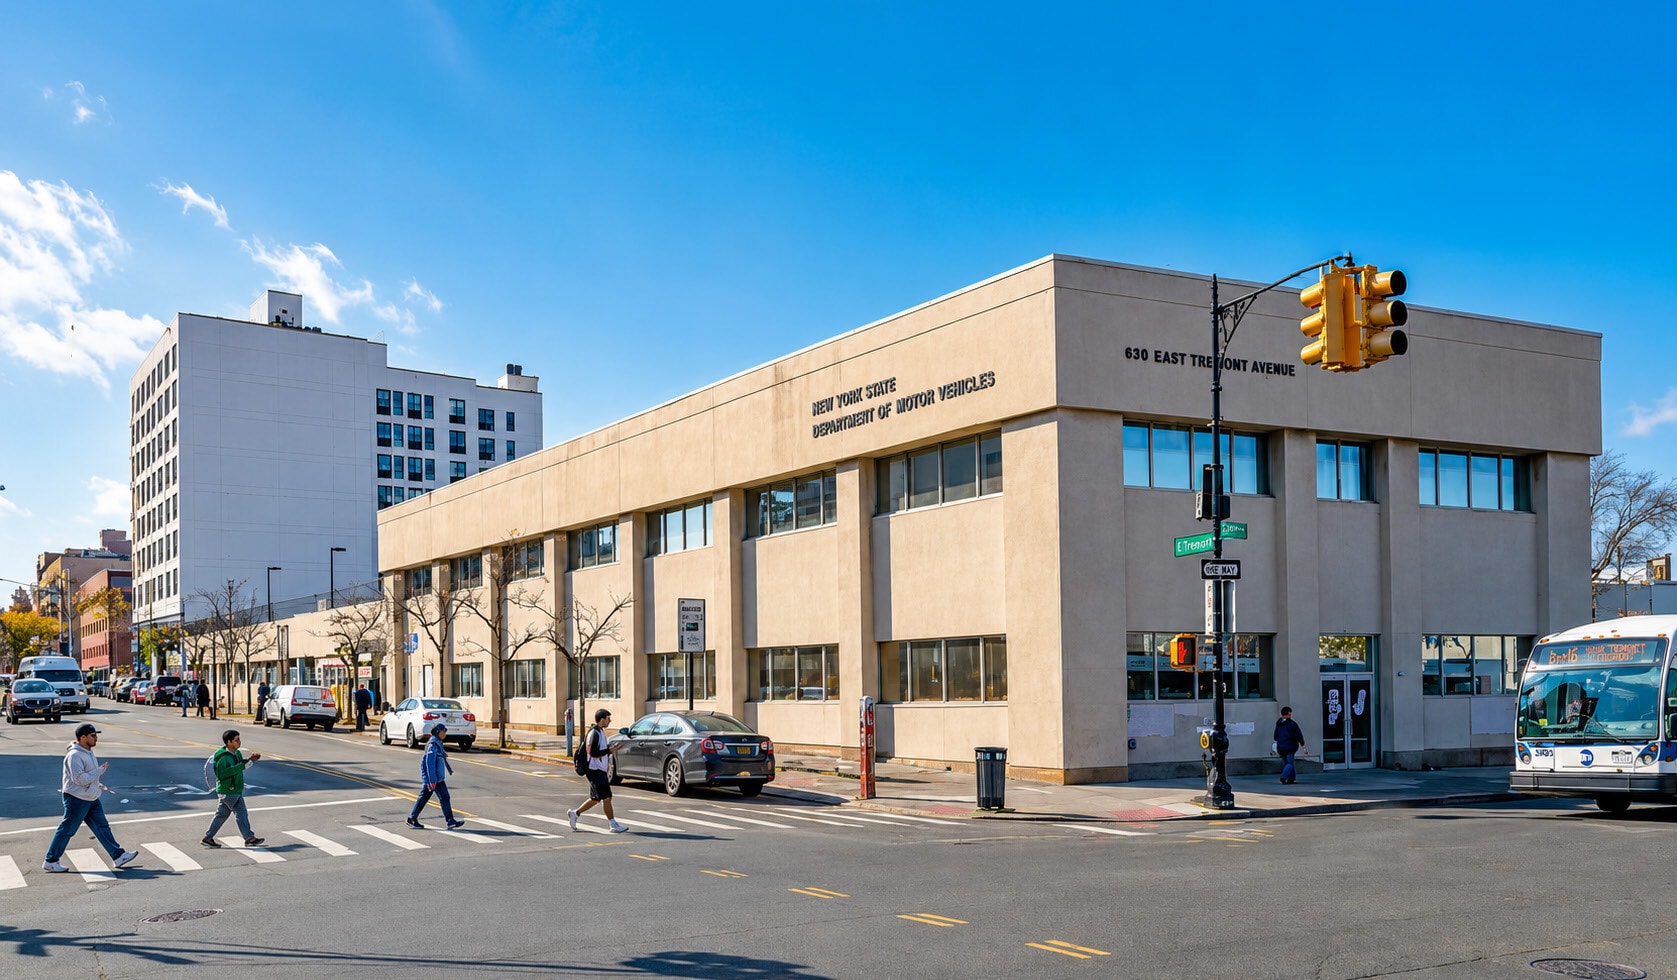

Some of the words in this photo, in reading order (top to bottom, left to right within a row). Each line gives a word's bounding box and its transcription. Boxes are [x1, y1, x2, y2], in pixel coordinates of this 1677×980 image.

[1125, 347, 1148, 361] 630
[1154, 350, 1187, 366] EAST
[1251, 360, 1296, 377] AVENUE
[812, 397, 834, 416] NEW
[836, 387, 863, 409] YORK
[866, 377, 897, 399] STATE
[812, 407, 875, 438] DEPARTMENT
[878, 403, 892, 420] OF
[896, 389, 935, 414] MOTOR
[938, 371, 996, 402] VEHICLES
[1177, 542, 1182, 552] E
